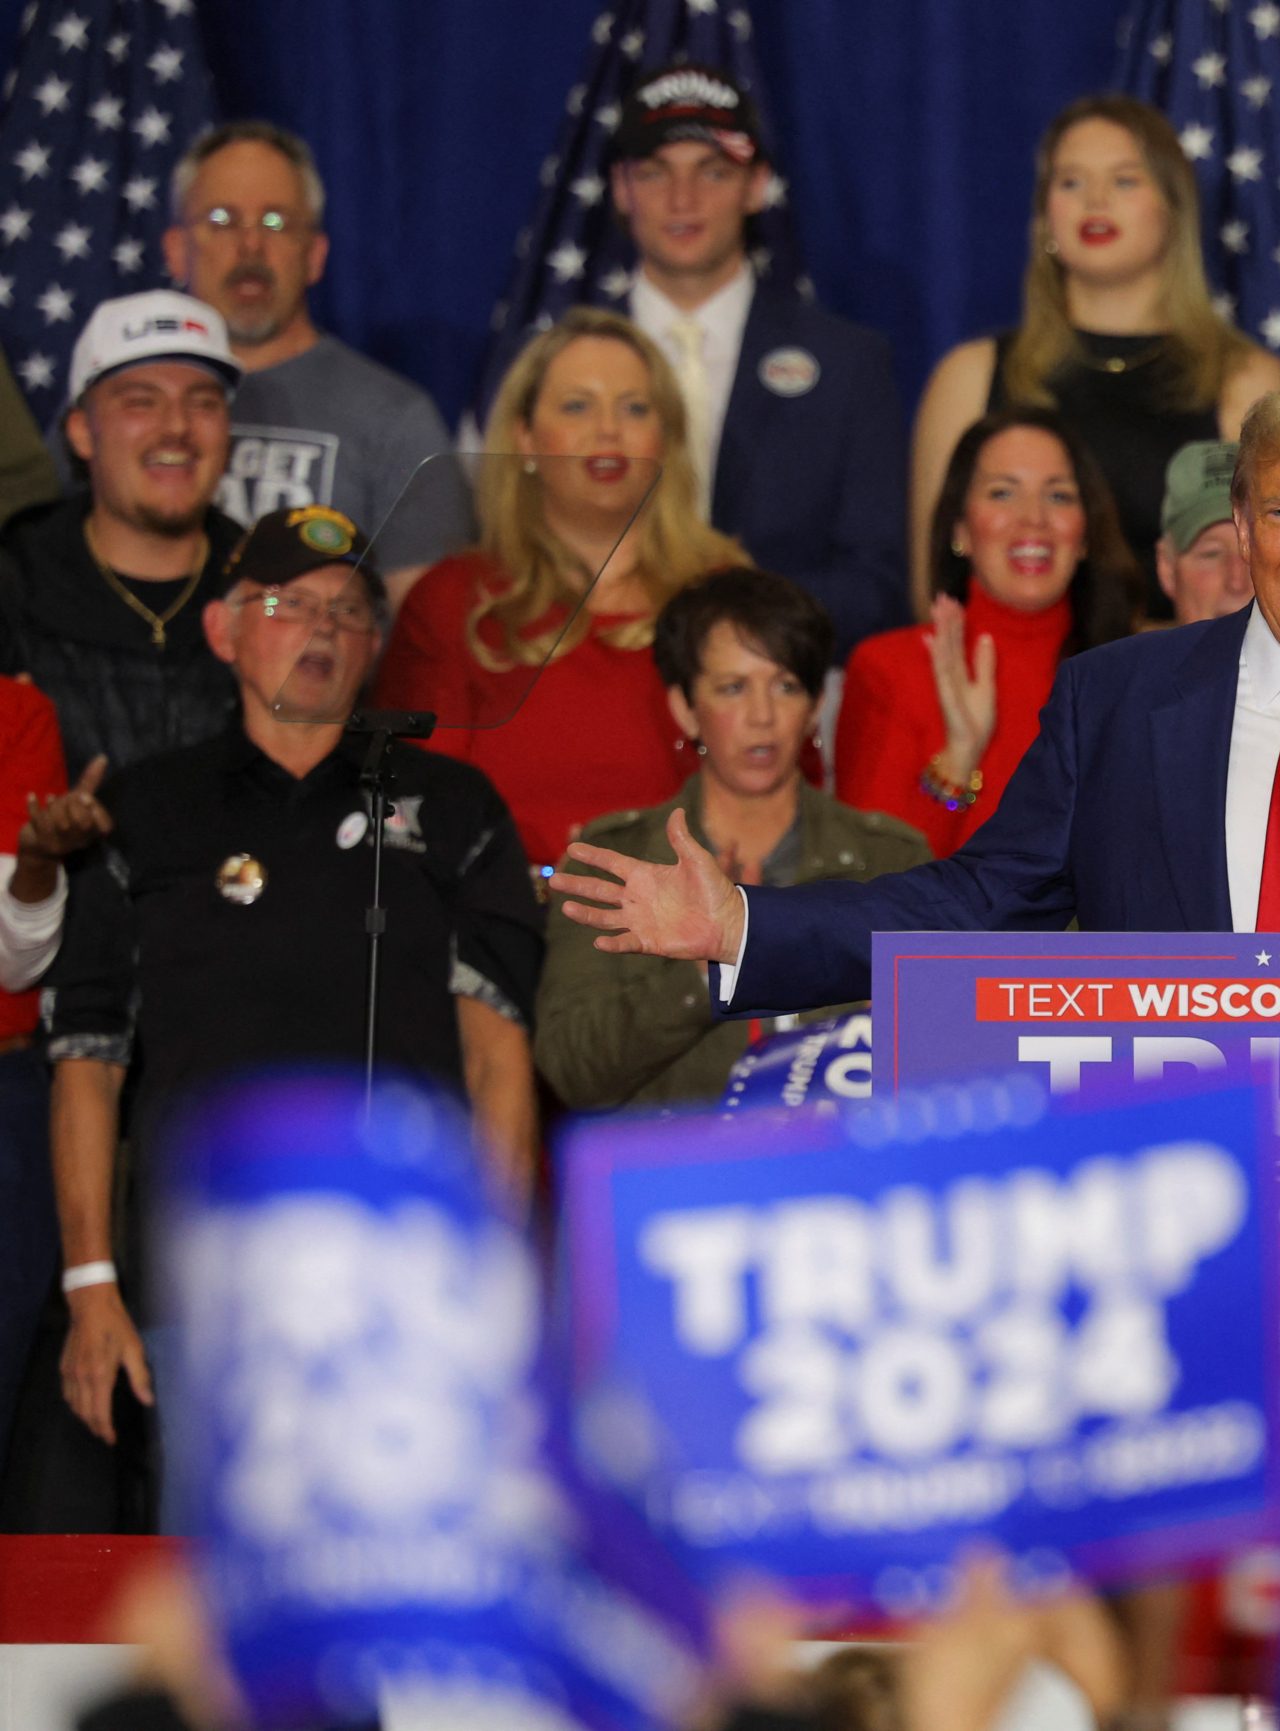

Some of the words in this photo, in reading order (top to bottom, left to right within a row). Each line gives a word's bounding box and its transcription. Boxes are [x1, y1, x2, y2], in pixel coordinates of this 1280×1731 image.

[998, 983, 1114, 1018] TEXT
[637, 1141, 1249, 1358] TRUMP
[736, 1295, 1182, 1478] 2024
